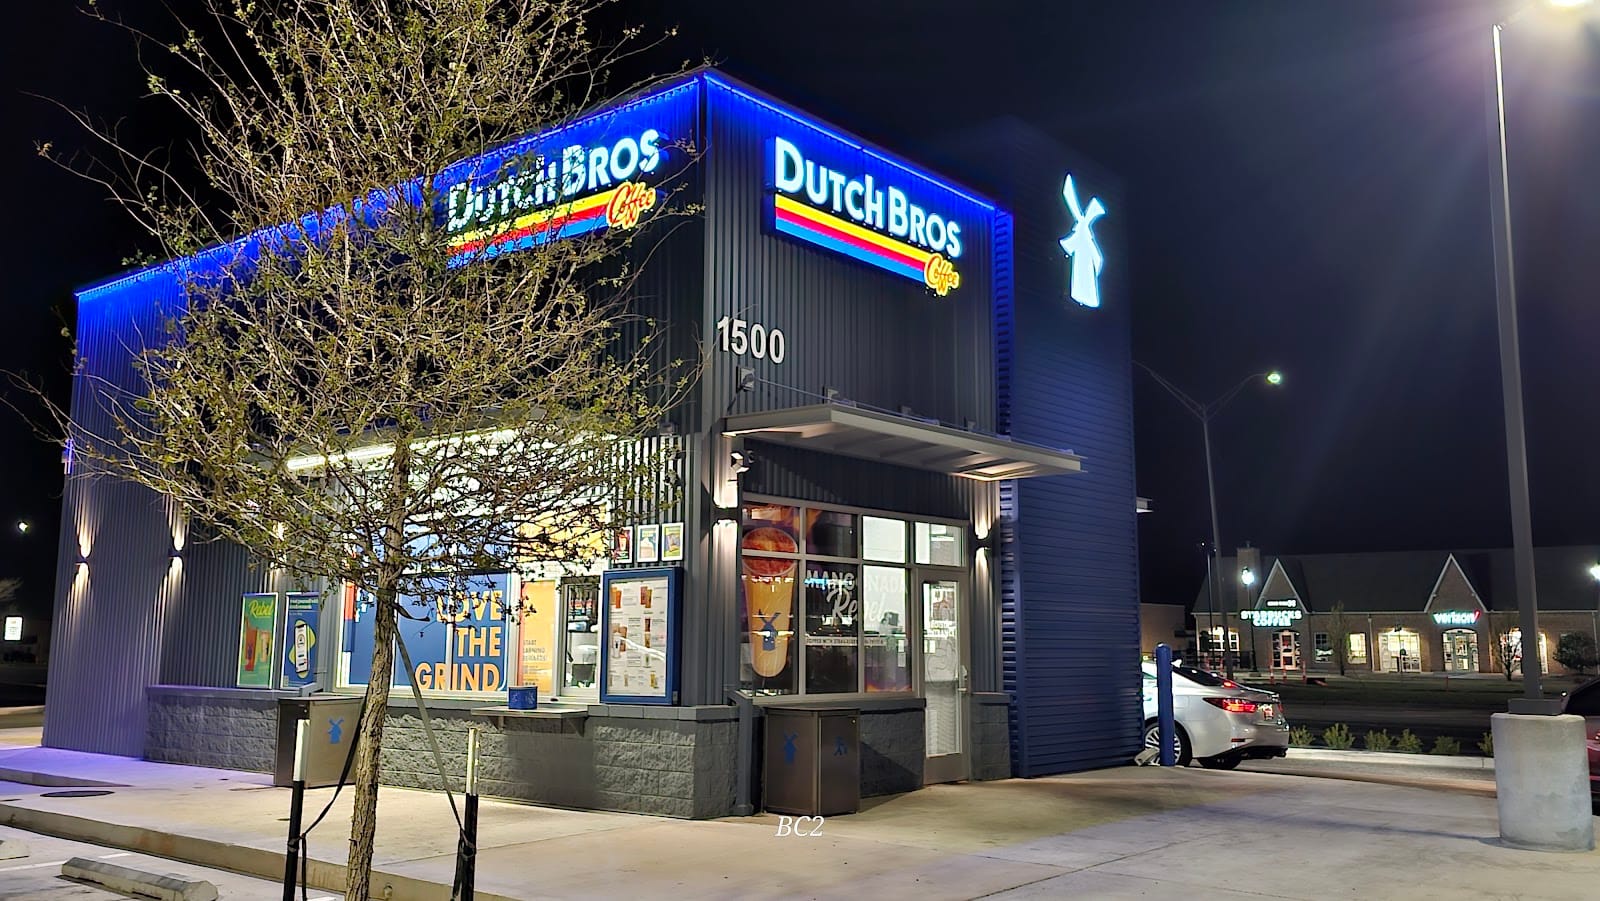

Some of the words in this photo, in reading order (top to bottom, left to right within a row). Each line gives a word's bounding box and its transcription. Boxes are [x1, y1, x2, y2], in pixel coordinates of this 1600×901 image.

[447, 154, 556, 232] DUTCH
[562, 129, 661, 196] BROS
[775, 136, 884, 229] DUTCH
[888, 185, 962, 258] BROS
[608, 183, 655, 227] Coffee
[926, 255, 959, 293] Coffee
[717, 315, 785, 364] 1500
[436, 589, 502, 622] LOVE
[1240, 610, 1302, 620] STARBUCKS
[1433, 611, 1478, 624] verizon
[1252, 618, 1292, 627] COFFEE
[456, 626, 501, 657] THE
[415, 662, 500, 692] GRIND
